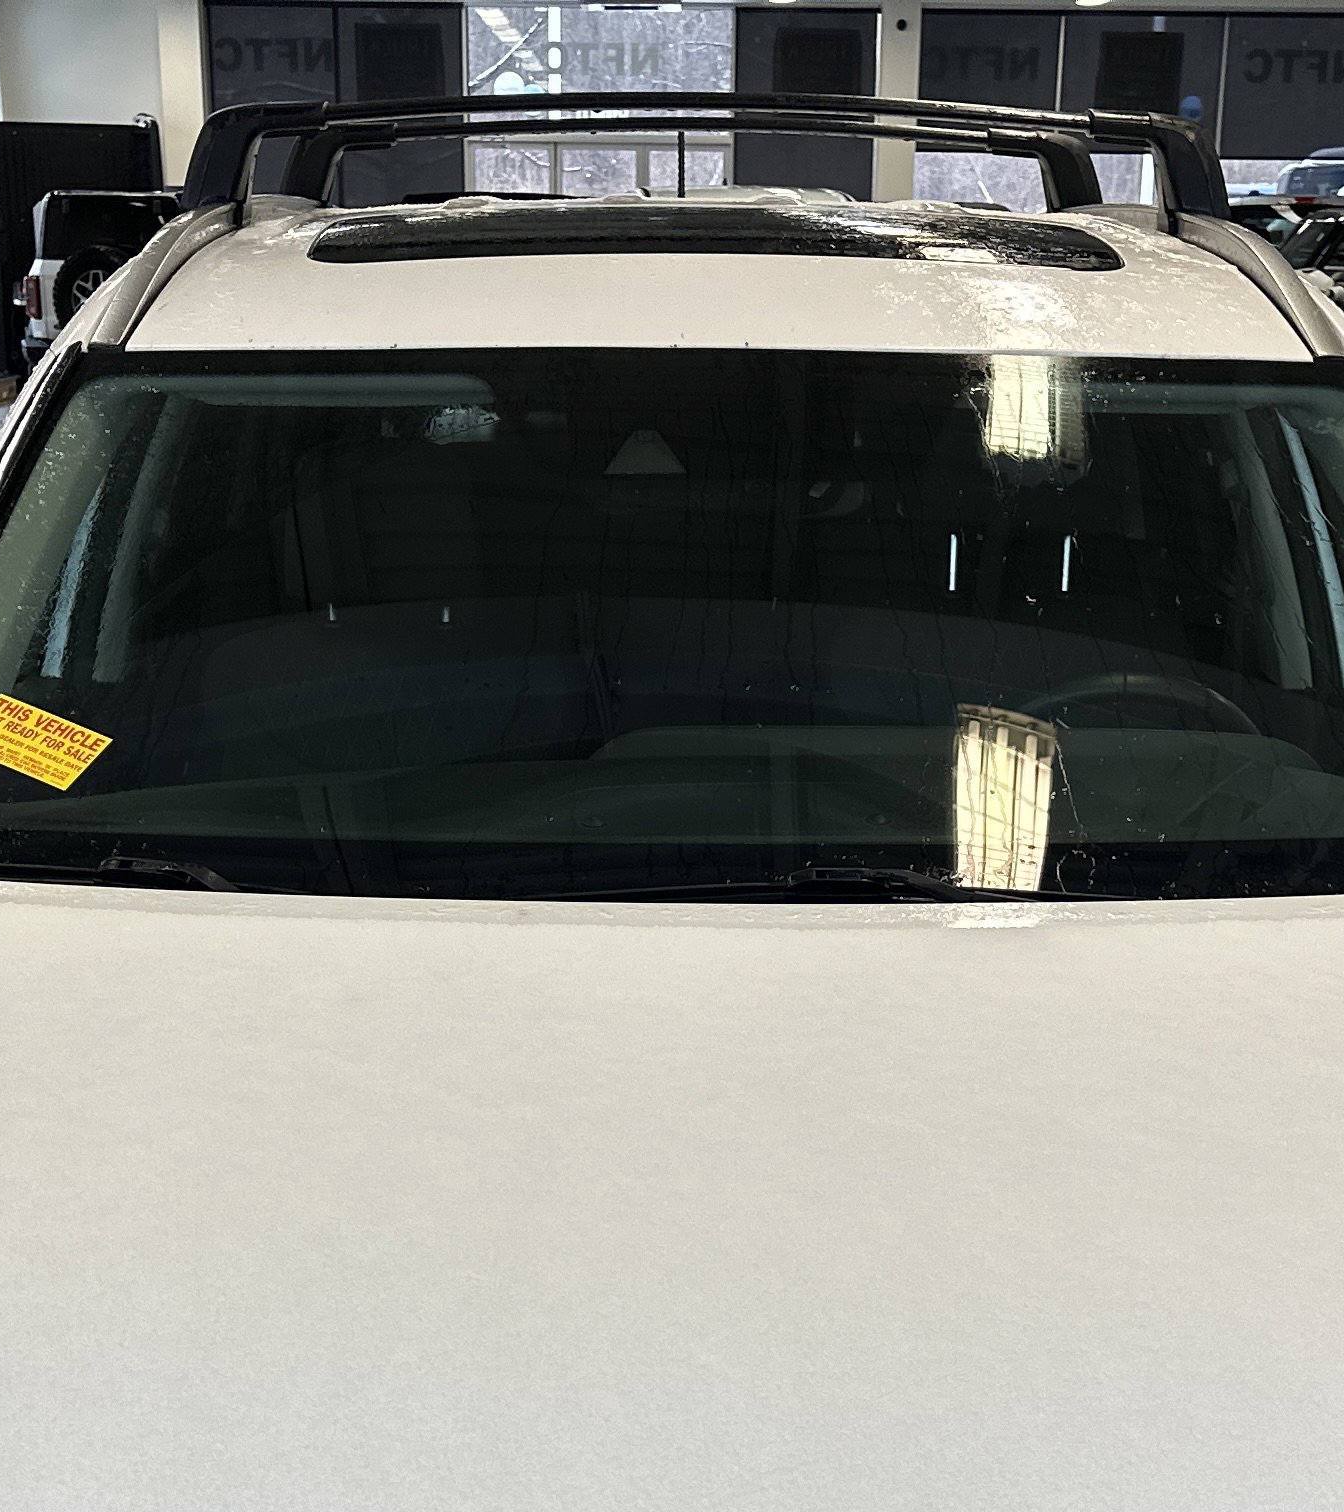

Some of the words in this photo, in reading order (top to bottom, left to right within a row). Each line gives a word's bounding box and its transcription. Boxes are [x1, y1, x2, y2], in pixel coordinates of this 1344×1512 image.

[2, 721, 42, 741] READY
[39, 736, 65, 751] FOR
[63, 746, 94, 764] SALE
[34, 714, 105, 752] VEHICLE
